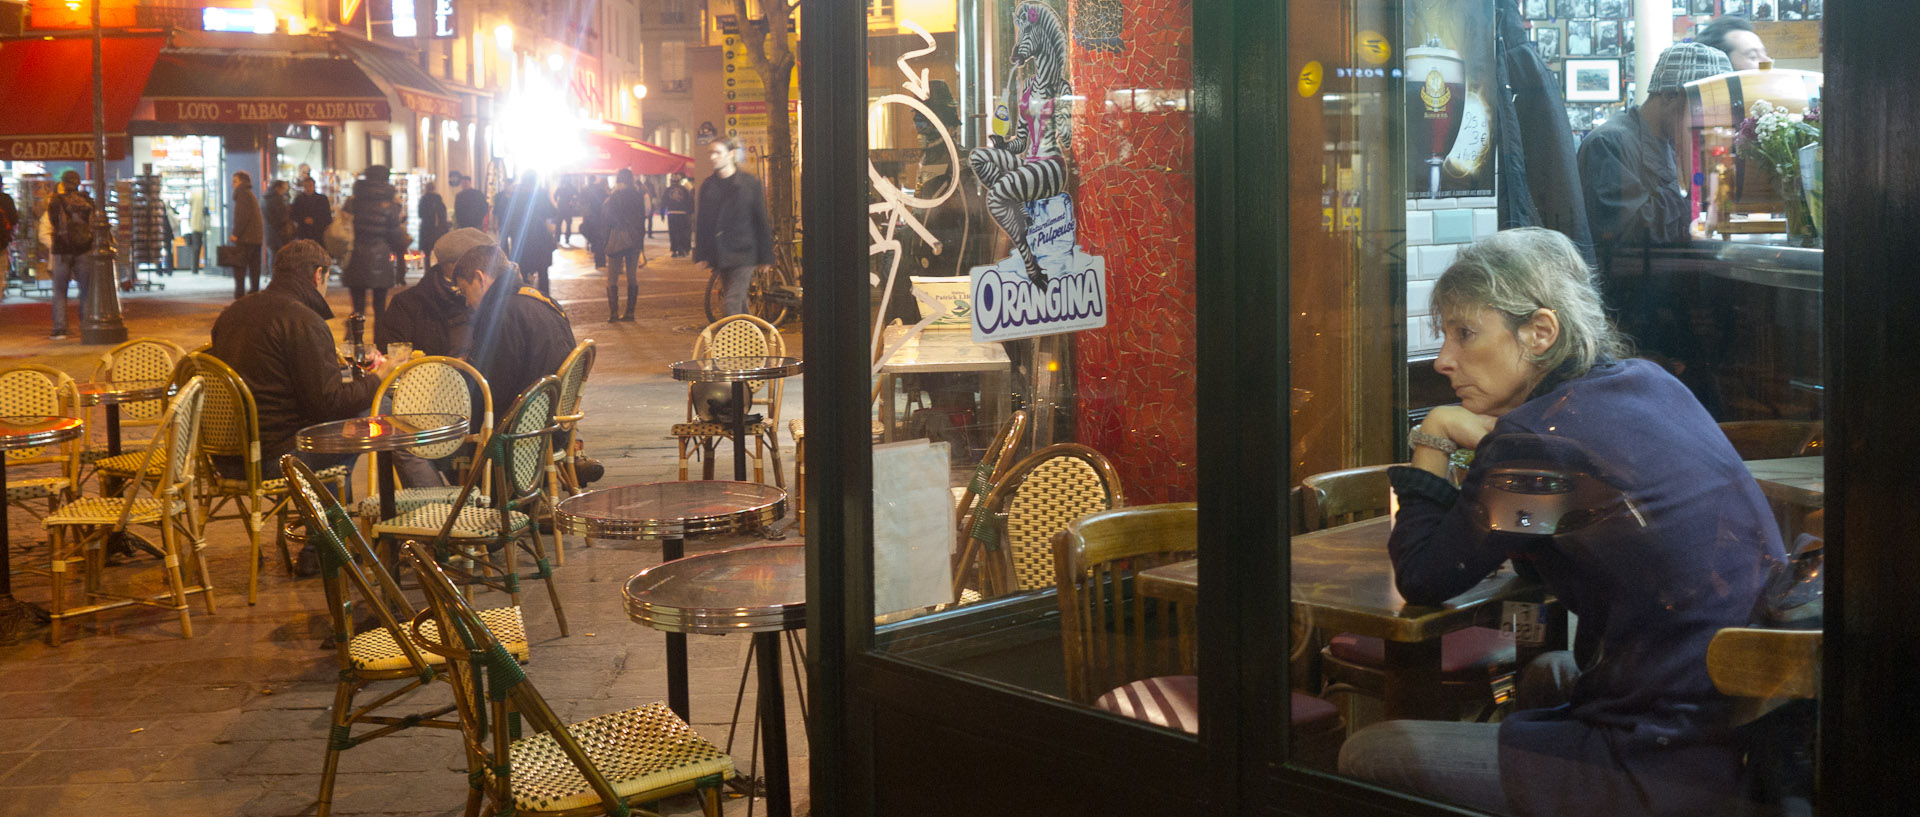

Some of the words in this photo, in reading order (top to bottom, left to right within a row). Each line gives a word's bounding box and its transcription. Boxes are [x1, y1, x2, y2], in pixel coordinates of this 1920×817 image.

[177, 102, 220, 120] LOTO
[237, 103, 289, 120] TABAC
[305, 102, 377, 119] CADEAUX
[11, 141, 96, 159] CADEAUX
[1037, 220, 1075, 247] Pulpeuse
[975, 269, 1103, 335] ORANGINA
